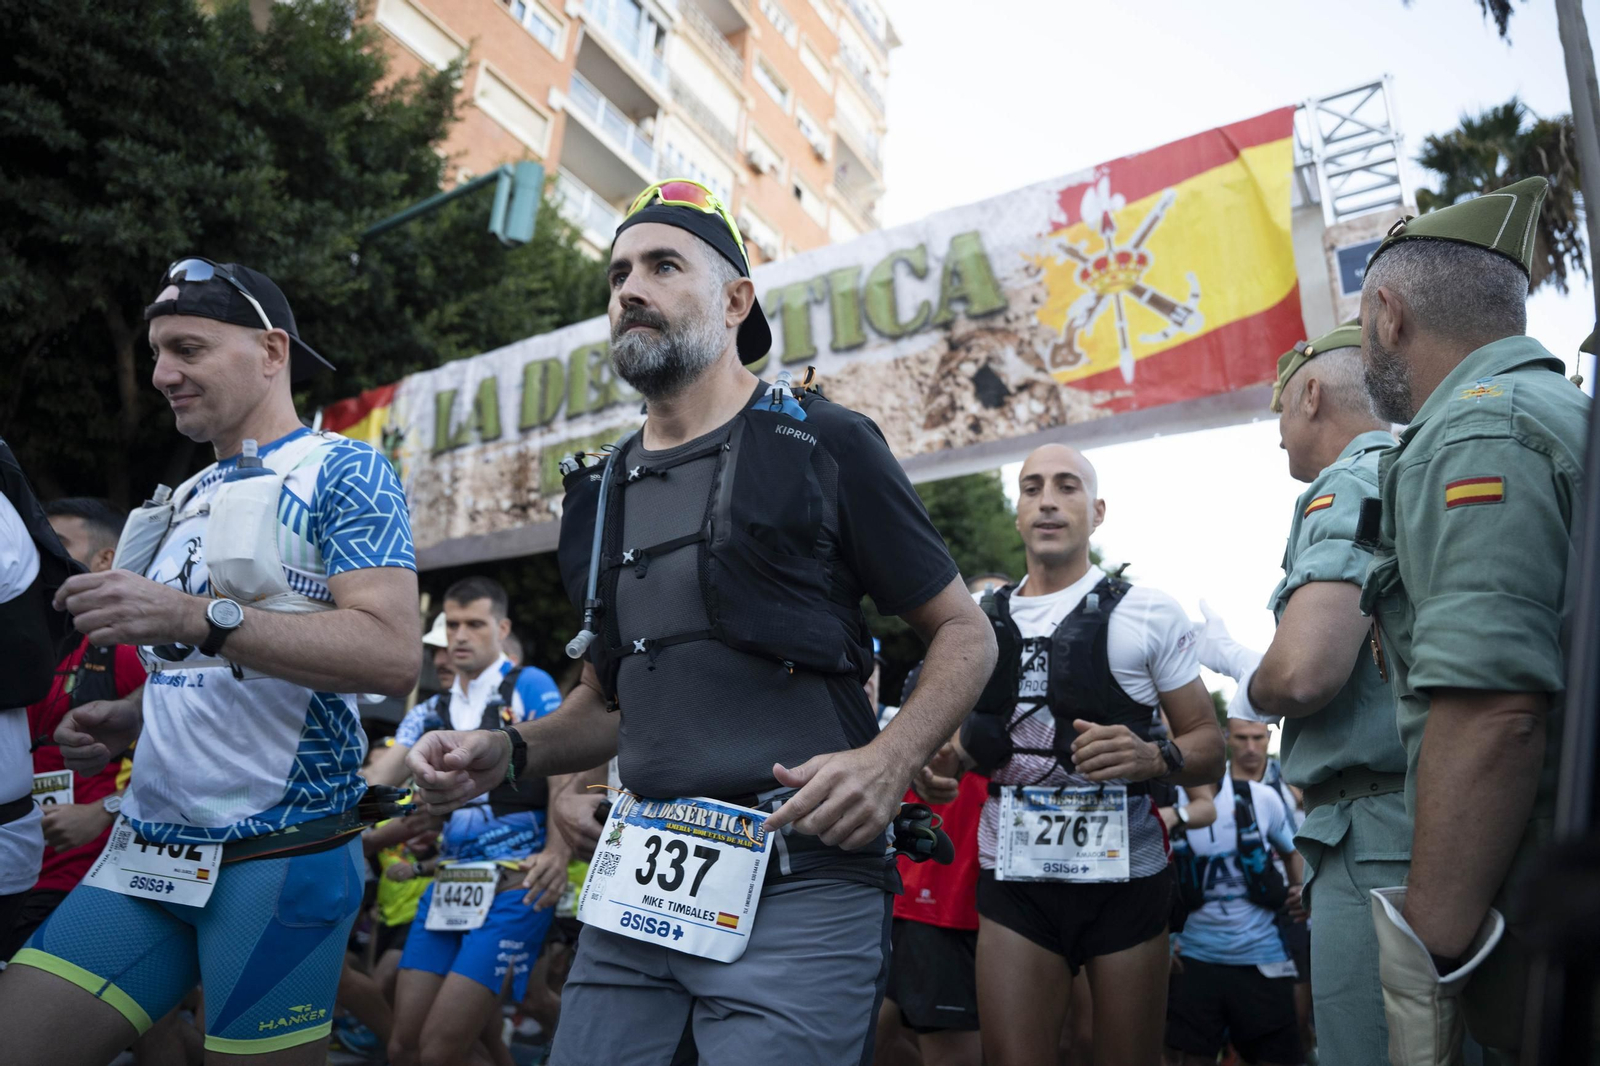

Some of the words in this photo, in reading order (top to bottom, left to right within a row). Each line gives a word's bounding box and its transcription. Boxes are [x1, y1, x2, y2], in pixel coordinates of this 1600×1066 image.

[432, 374, 502, 456] LA
[775, 424, 818, 447] KIPRUN
[642, 801, 661, 819] LA
[658, 802, 755, 839] DESÉRTICA
[1034, 814, 1109, 847] 2767
[726, 835, 736, 844] DE
[737, 838, 753, 848] MAR
[635, 834, 721, 898] 337
[1043, 862, 1080, 874] asisa
[129, 875, 165, 894] asisa
[443, 885, 484, 907] 4420
[641, 894, 664, 909] MIKE
[668, 900, 716, 922] TIMBALES
[620, 911, 670, 938] asisa
[258, 1009, 327, 1032] HANKER
